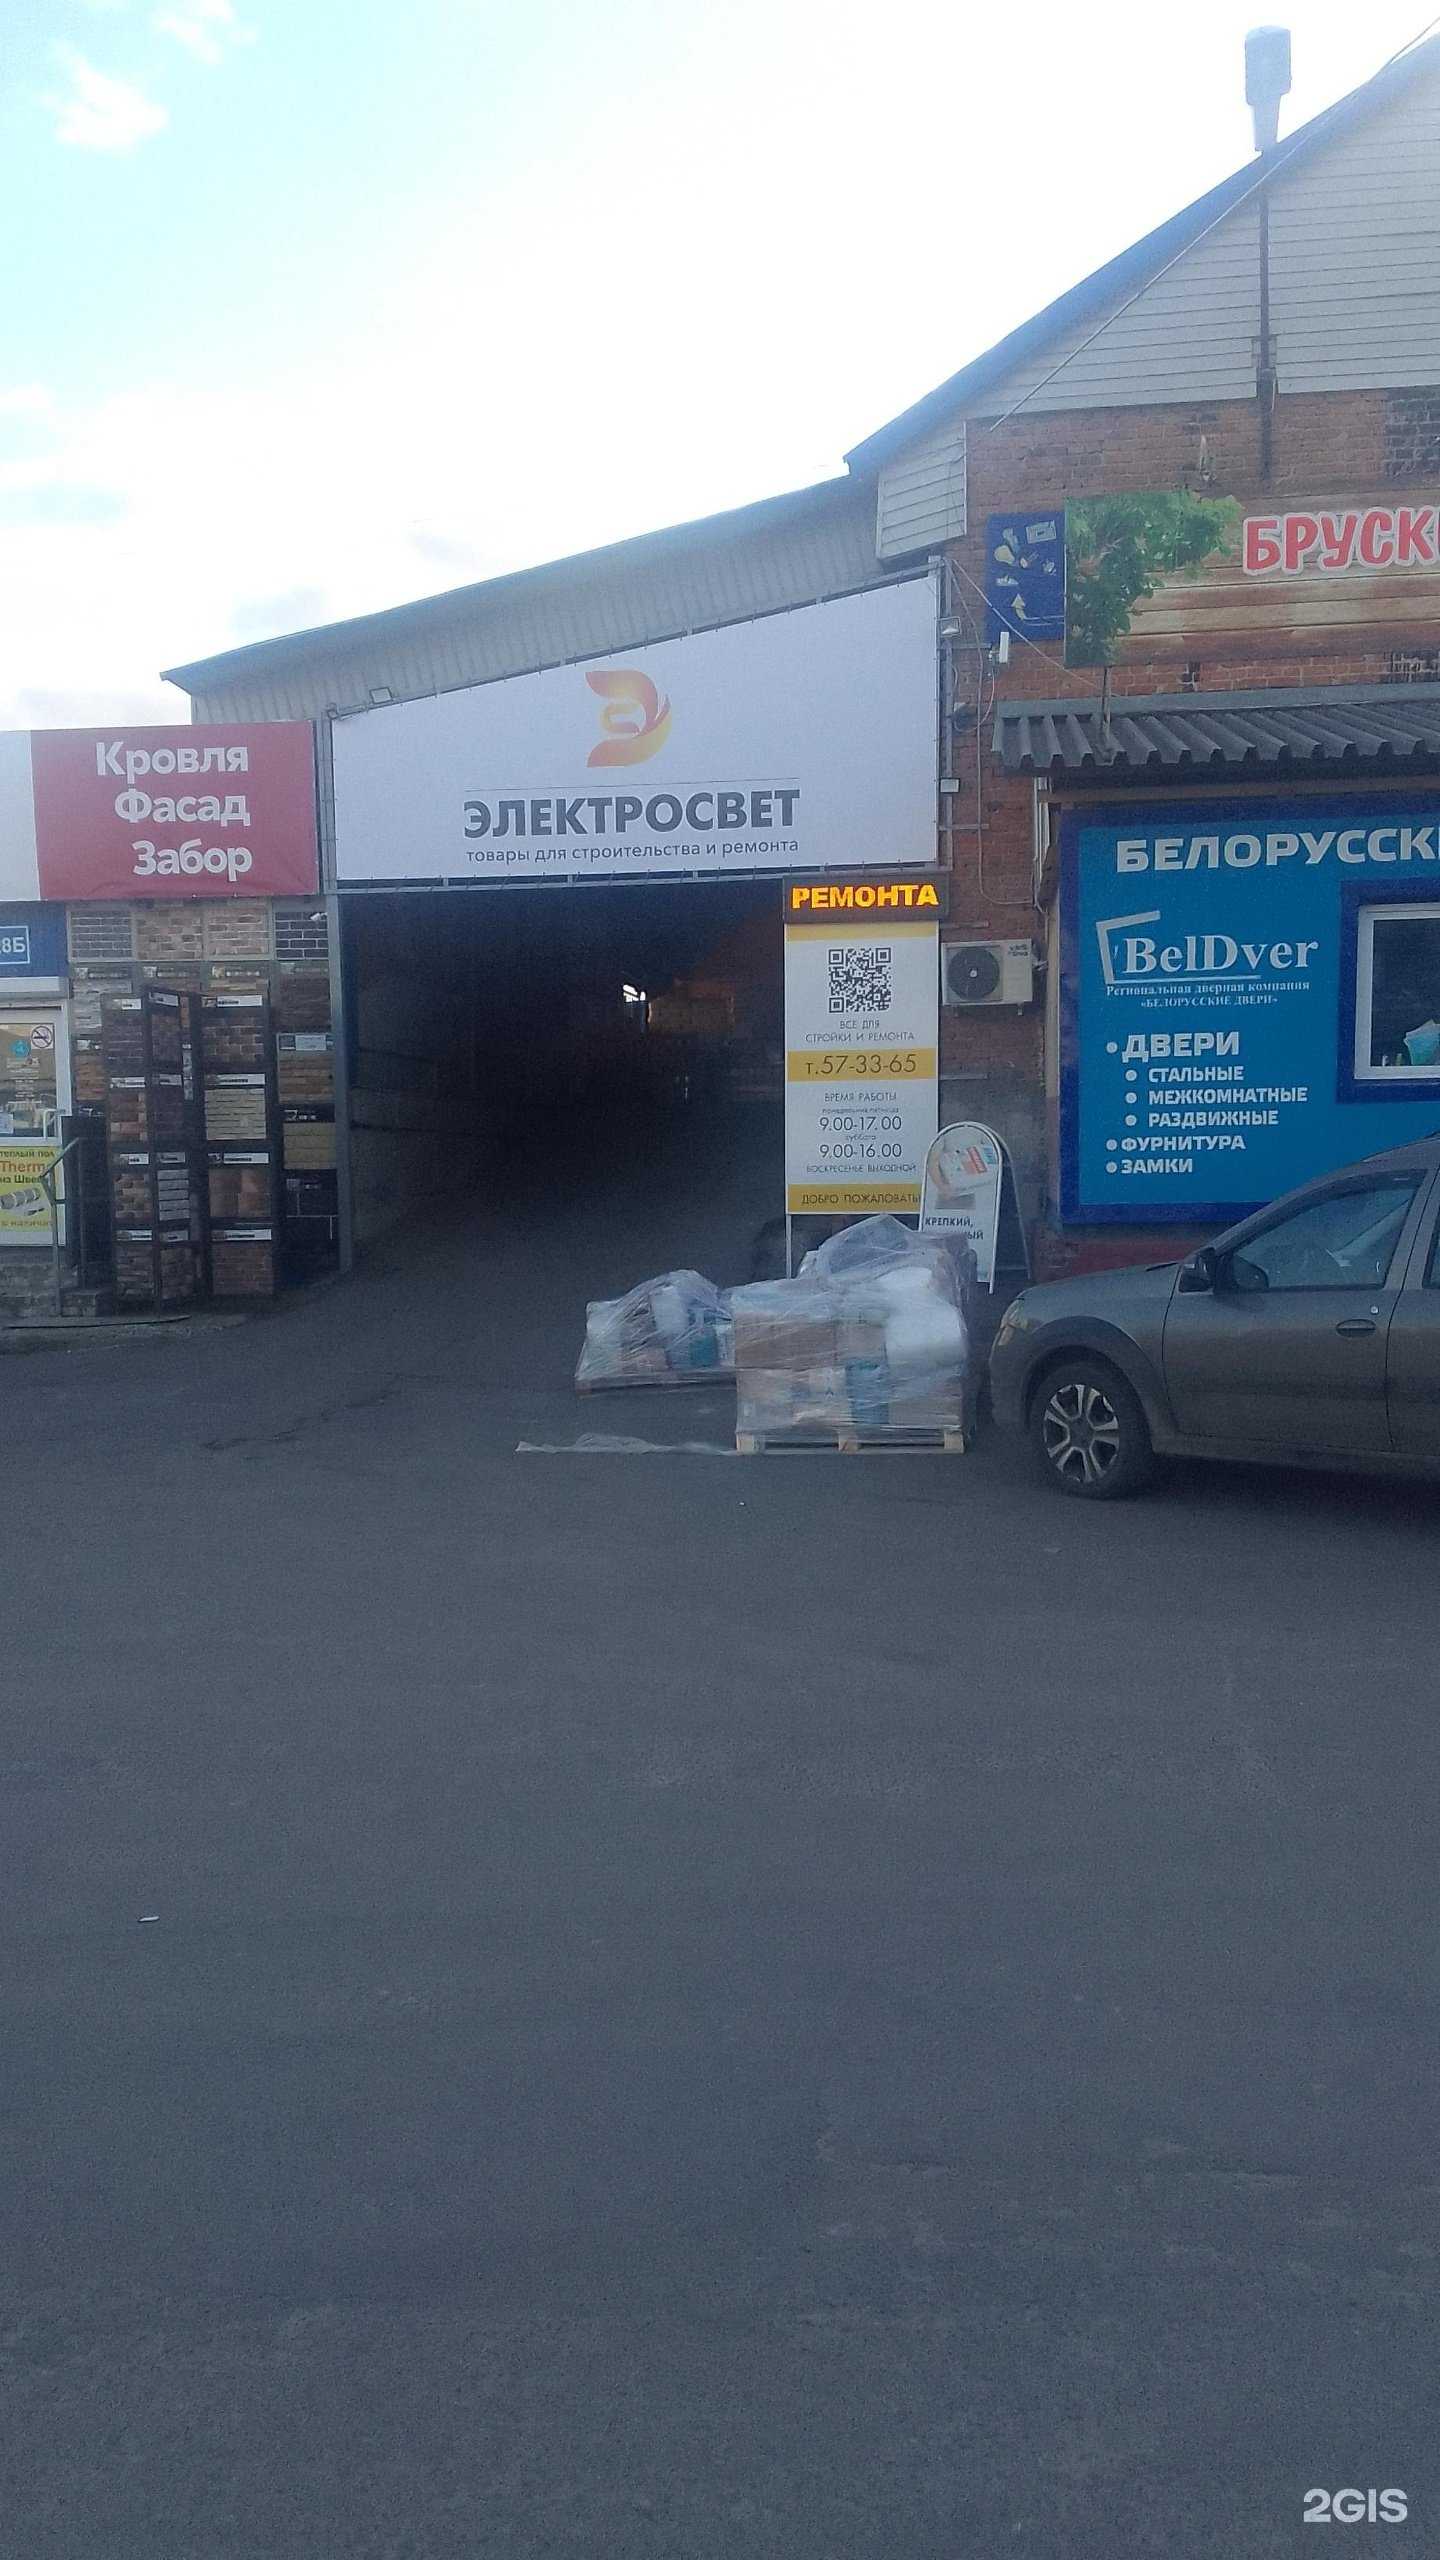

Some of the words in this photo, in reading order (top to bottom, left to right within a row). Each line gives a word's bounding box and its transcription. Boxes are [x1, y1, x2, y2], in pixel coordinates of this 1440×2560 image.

[1243, 505, 1440, 574] БРУСК
[96, 740, 249, 784] Кровля
[114, 788, 250, 827] Фасад
[463, 788, 800, 838] ЭЛЕКТРОСВЕТ
[466, 848, 530, 864] товары
[535, 847, 567, 862] для
[571, 842, 701, 863] строительства
[706, 845, 717, 855] и
[722, 840, 799, 858] ремонта
[1116, 827, 1440, 872] БЕЛОРУССК
[132, 839, 253, 881] Забор
[791, 884, 939, 909] РЕМОНТА
[0, 936, 26, 953] 8Б
[1122, 934, 1319, 974] BelDver
[840, 1020, 857, 1029] ВСЕ
[862, 1020, 880, 1030] ДЛЯ
[805, 1033, 851, 1043] СТРОЙКИ
[868, 1031, 914, 1041] РЕМОНТА
[1122, 1032, 1240, 1063] ДВЕРИ
[1148, 1066, 1245, 1083] СТАЛЬНЫЕ
[858, 1092, 897, 1101] РАБОТЫ
[1148, 1087, 1308, 1105] МЕЖКОМНАТНЫЕ
[1148, 1110, 1279, 1128] РАЗДВИЖНЫЕ
[1121, 1135, 1246, 1152] ФУРНИТУРА
[1121, 1158, 1193, 1175] ЗАМКИ
[802, 1194, 839, 1204] ДОБРО
[925, 1216, 974, 1227] КРЕПКИЙ,
